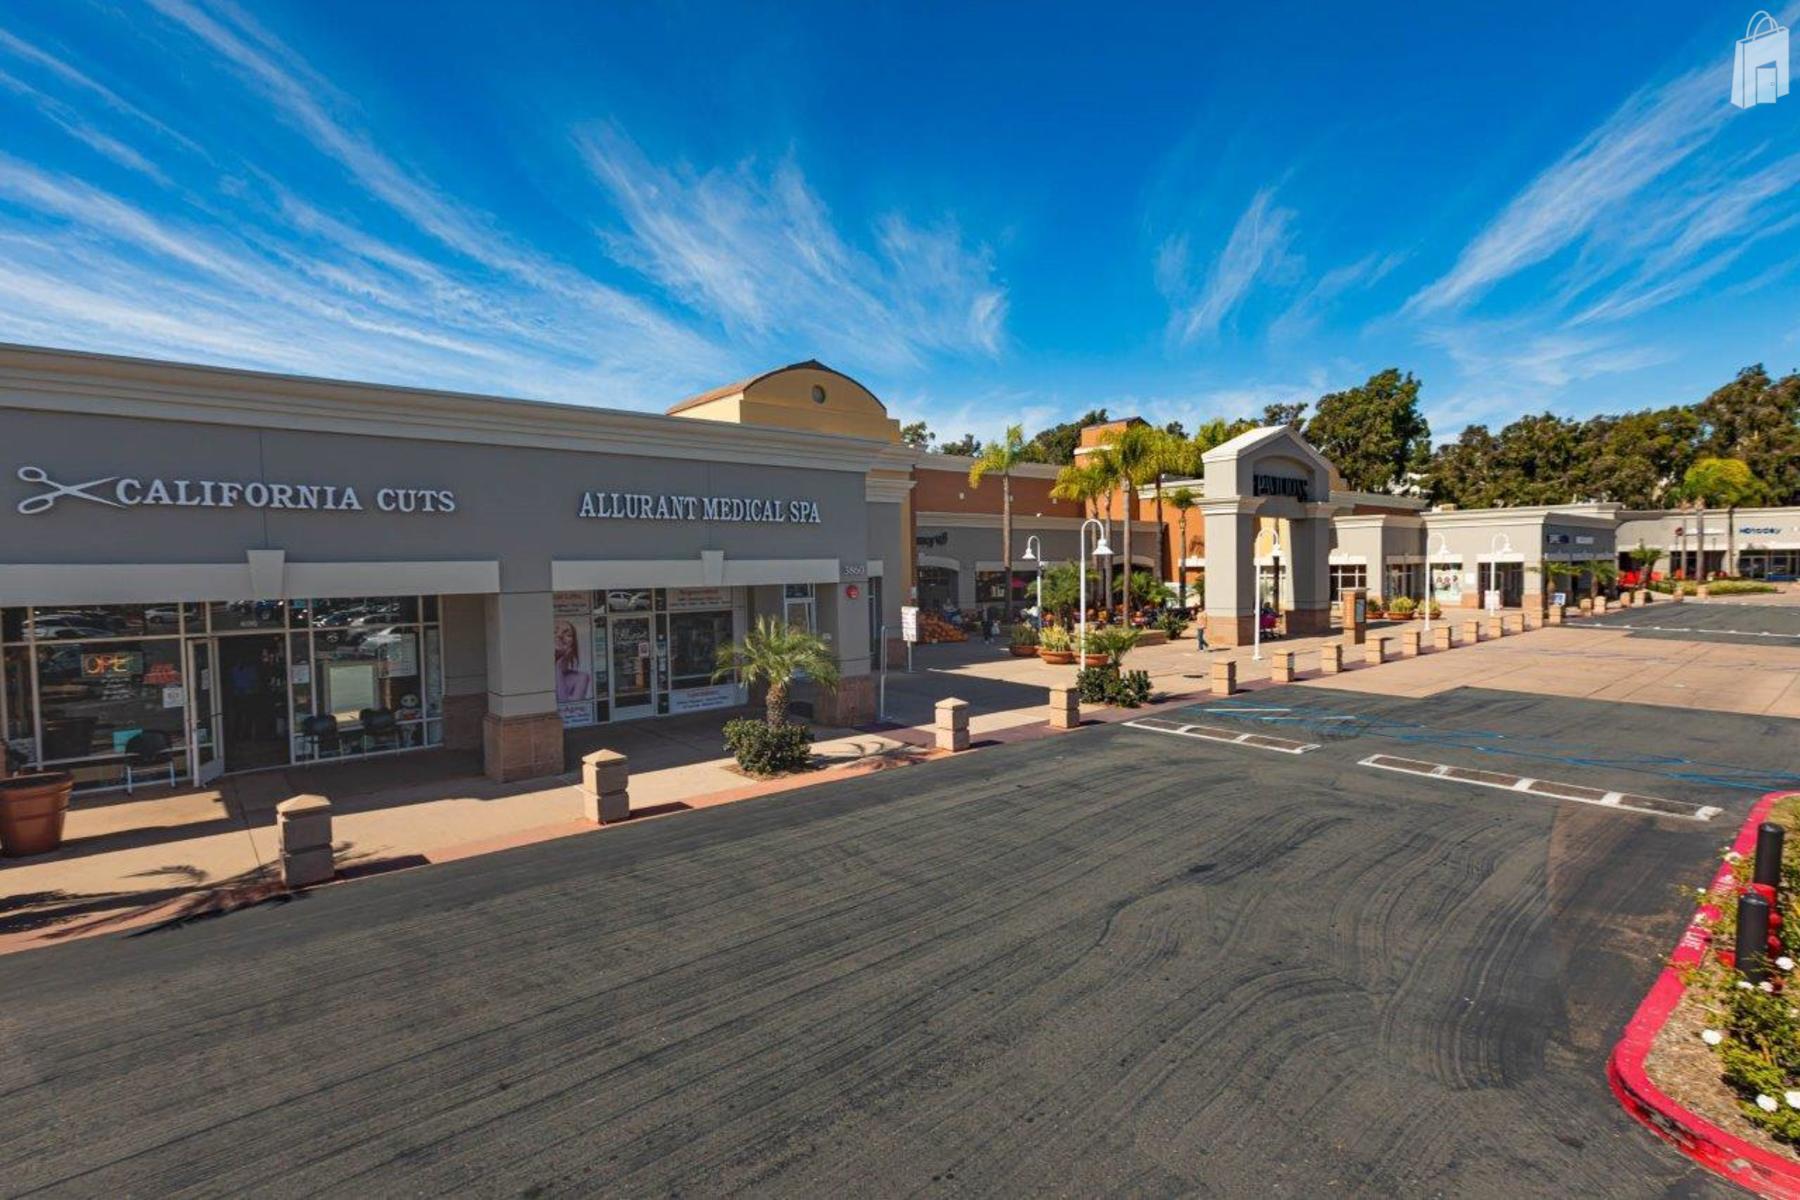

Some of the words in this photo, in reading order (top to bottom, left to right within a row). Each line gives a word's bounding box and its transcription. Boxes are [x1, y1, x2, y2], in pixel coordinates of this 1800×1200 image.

[115, 478, 363, 511] CALIFORNIA
[376, 487, 457, 513] CUTS
[579, 491, 698, 520] ALLURANT
[702, 497, 785, 522] MEDICAL
[789, 501, 821, 523] SPA
[83, 654, 140, 675] OPE
